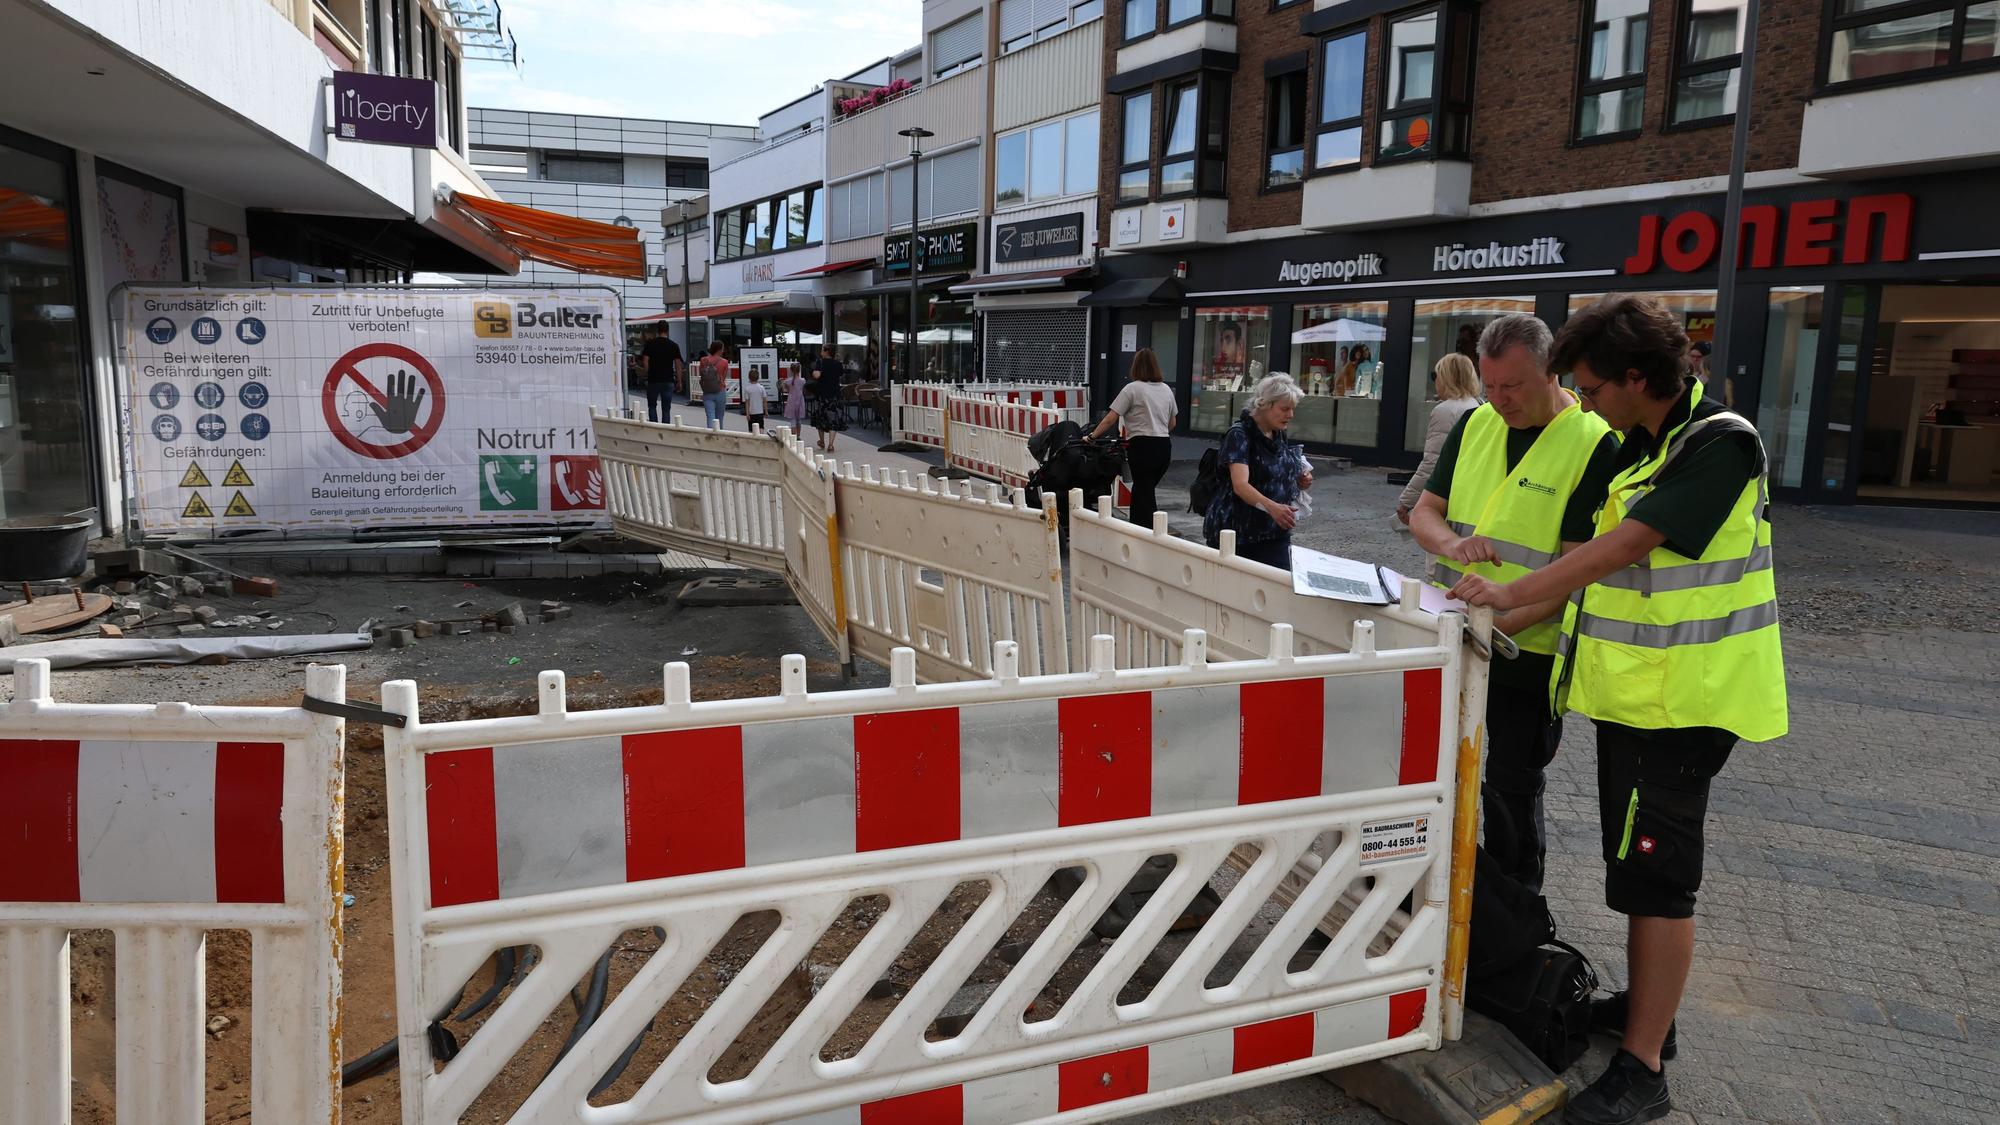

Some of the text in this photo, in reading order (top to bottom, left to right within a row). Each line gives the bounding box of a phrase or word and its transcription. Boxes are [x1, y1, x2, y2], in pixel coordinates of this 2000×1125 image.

[341, 88, 429, 130] liberty
[1035, 225, 1078, 246] JUWELIER
[1624, 192, 1915, 276] JONEN
[929, 232, 964, 256] PHONE
[1433, 236, 1565, 272] Hörakustik
[754, 263, 773, 282] PARIS
[1278, 252, 1384, 286] Augenoptik
[144, 300, 267, 315] Grundsätzlich gilt:
[312, 305, 444, 320] Zutritt für Unbefugte
[517, 303, 603, 329] Balter
[348, 321, 410, 332] verboten!
[518, 331, 605, 340] BAUUNTERNEHMUNG
[164, 352, 250, 364] Bei weiteren
[475, 352, 607, 365] 53940 Losheim/Eifel
[144, 366, 272, 380] Gefährdungen gilt:
[478, 428, 598, 449] Notruf 11
[163, 447, 266, 461] Gefährdungen:
[322, 470, 445, 485] Anmeldung bei der
[311, 485, 457, 500] Bauleitung erforderlich
[344, 508, 370, 517] gemäß
[372, 505, 463, 515] Gefährdungsbeurteilung
[1363, 826, 1373, 834] HKL
[1374, 822, 1414, 832] BAUMASCHINEN
[1400, 837, 1414, 847] 555
[1416, 835, 1427, 844] 44
[1361, 845, 1426, 860] hkl-baumaschinen.de
